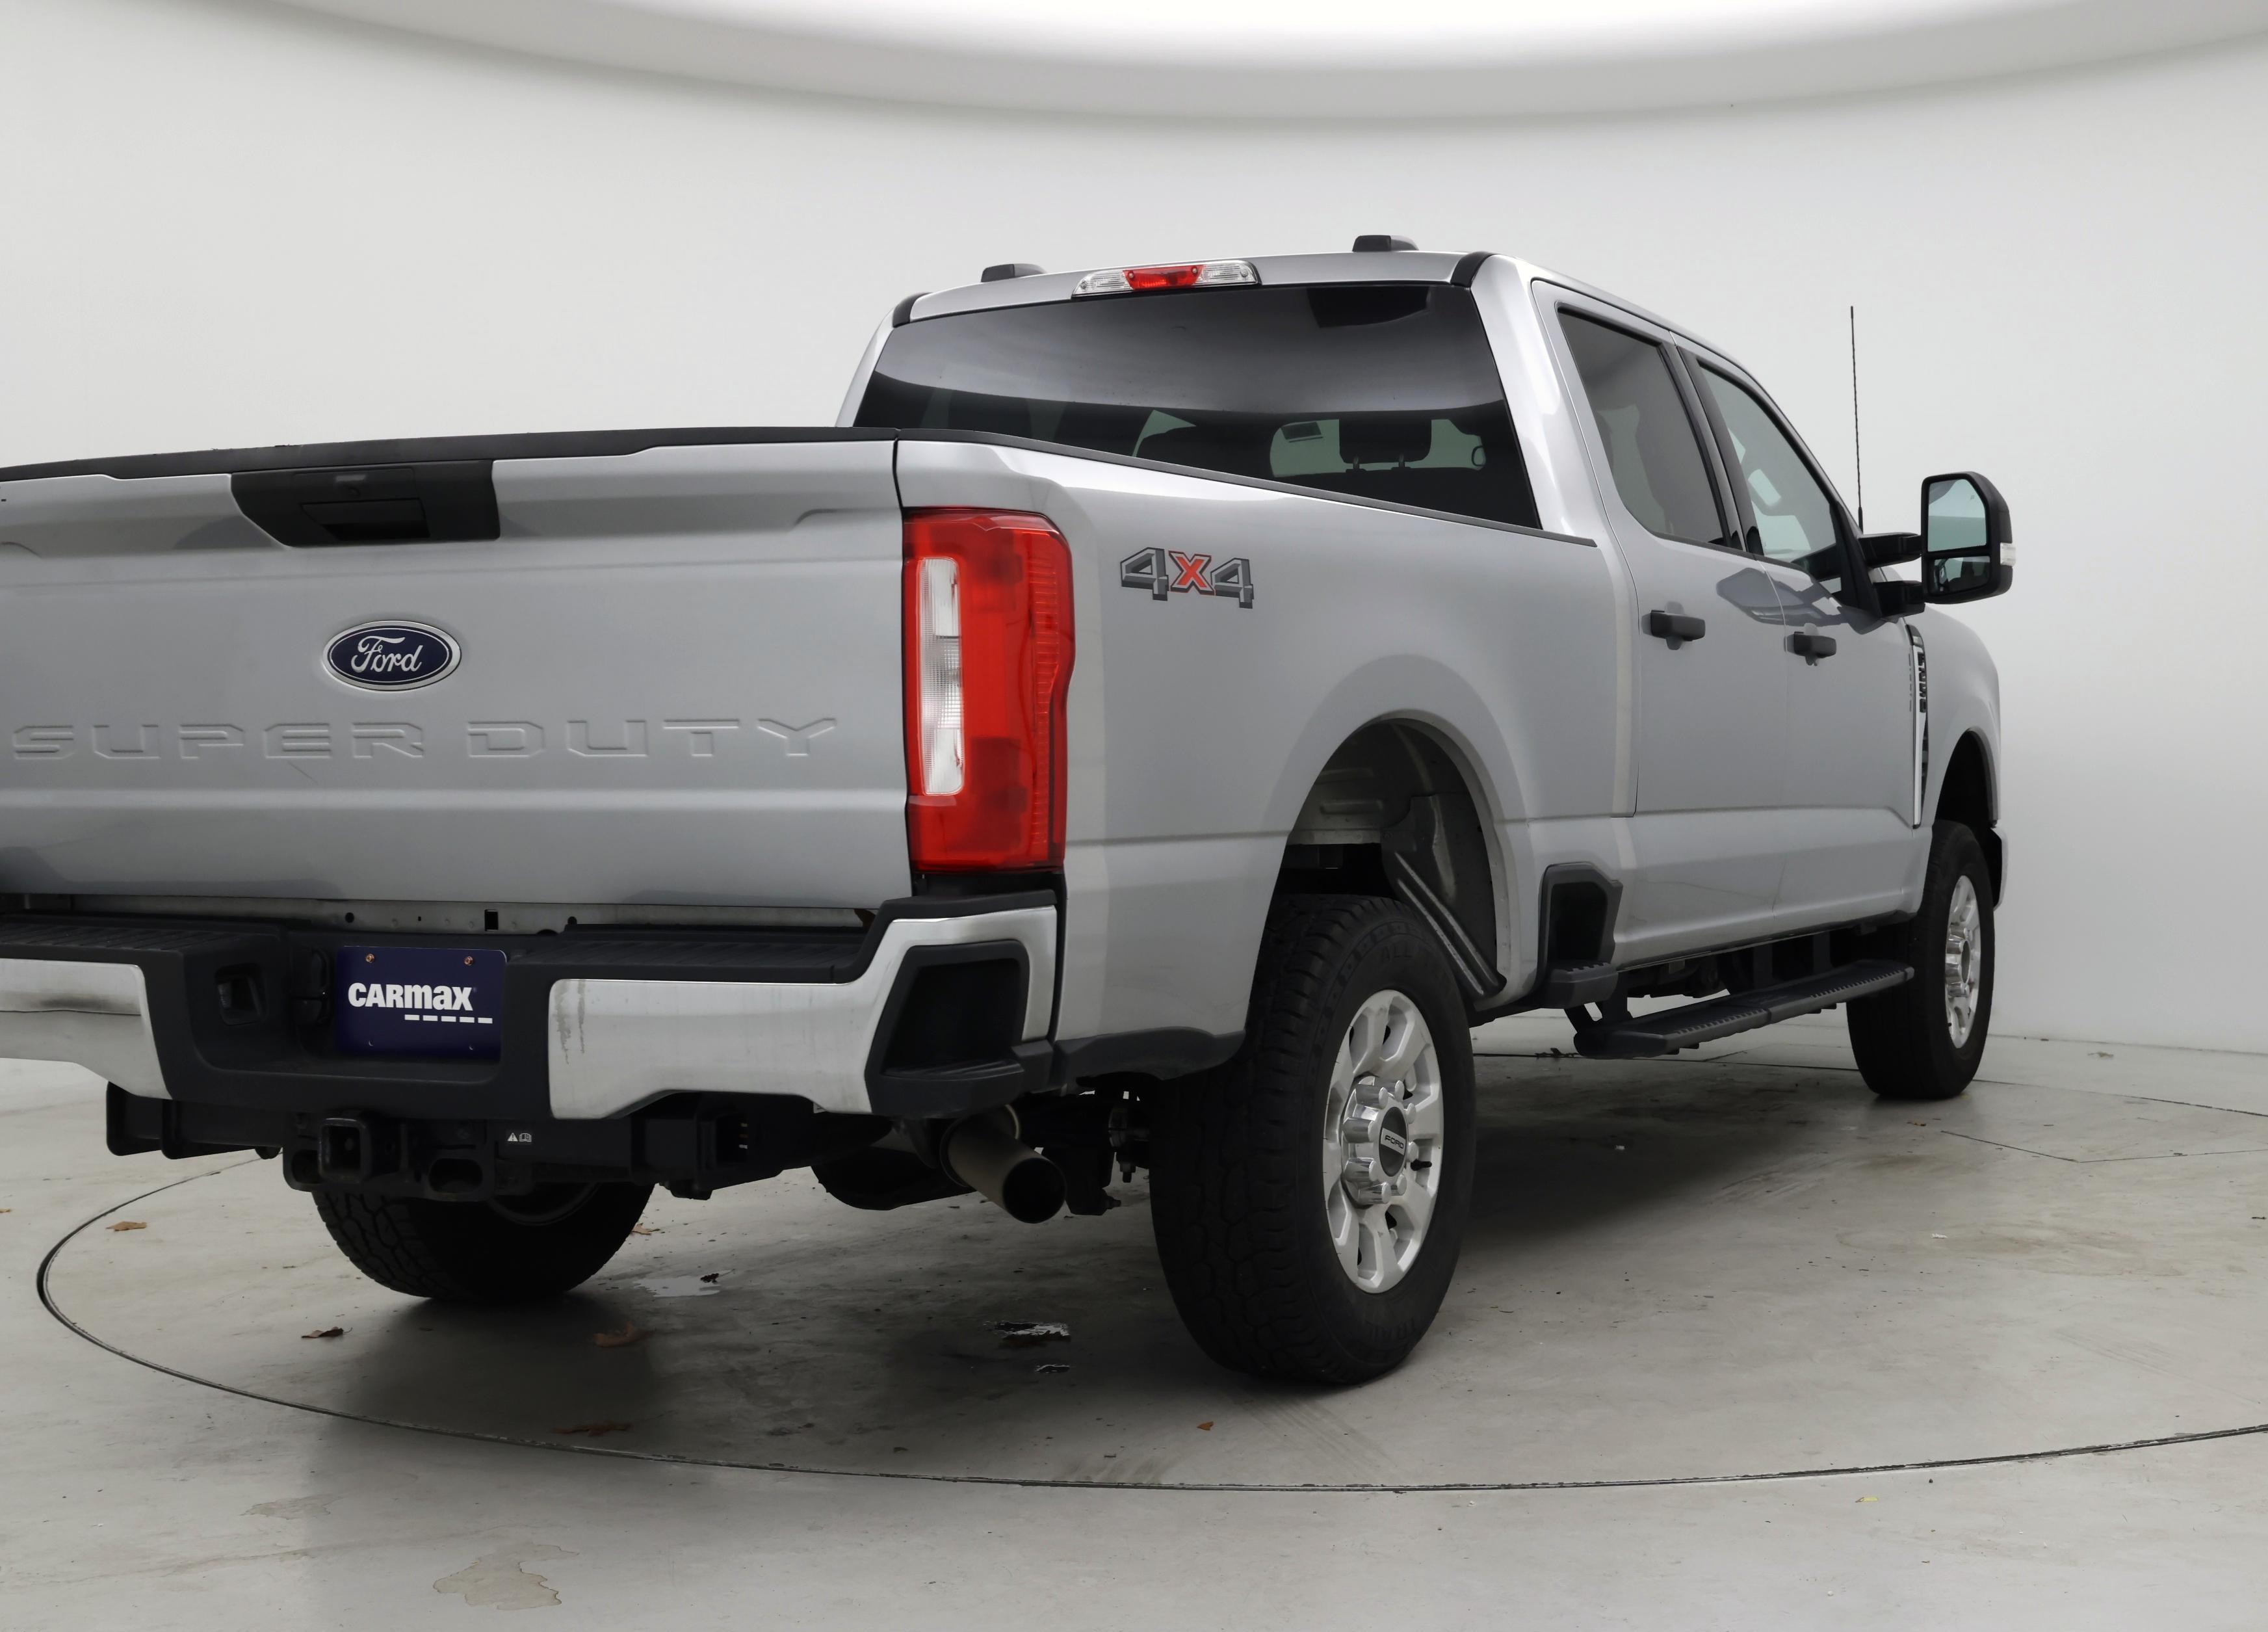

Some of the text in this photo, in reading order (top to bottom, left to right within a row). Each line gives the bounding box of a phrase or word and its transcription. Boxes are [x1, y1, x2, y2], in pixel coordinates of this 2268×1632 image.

[350, 635, 423, 673] Ford
[12, 718, 838, 760] SUPER DUTY
[1385, 1135, 1404, 1150] FORD
